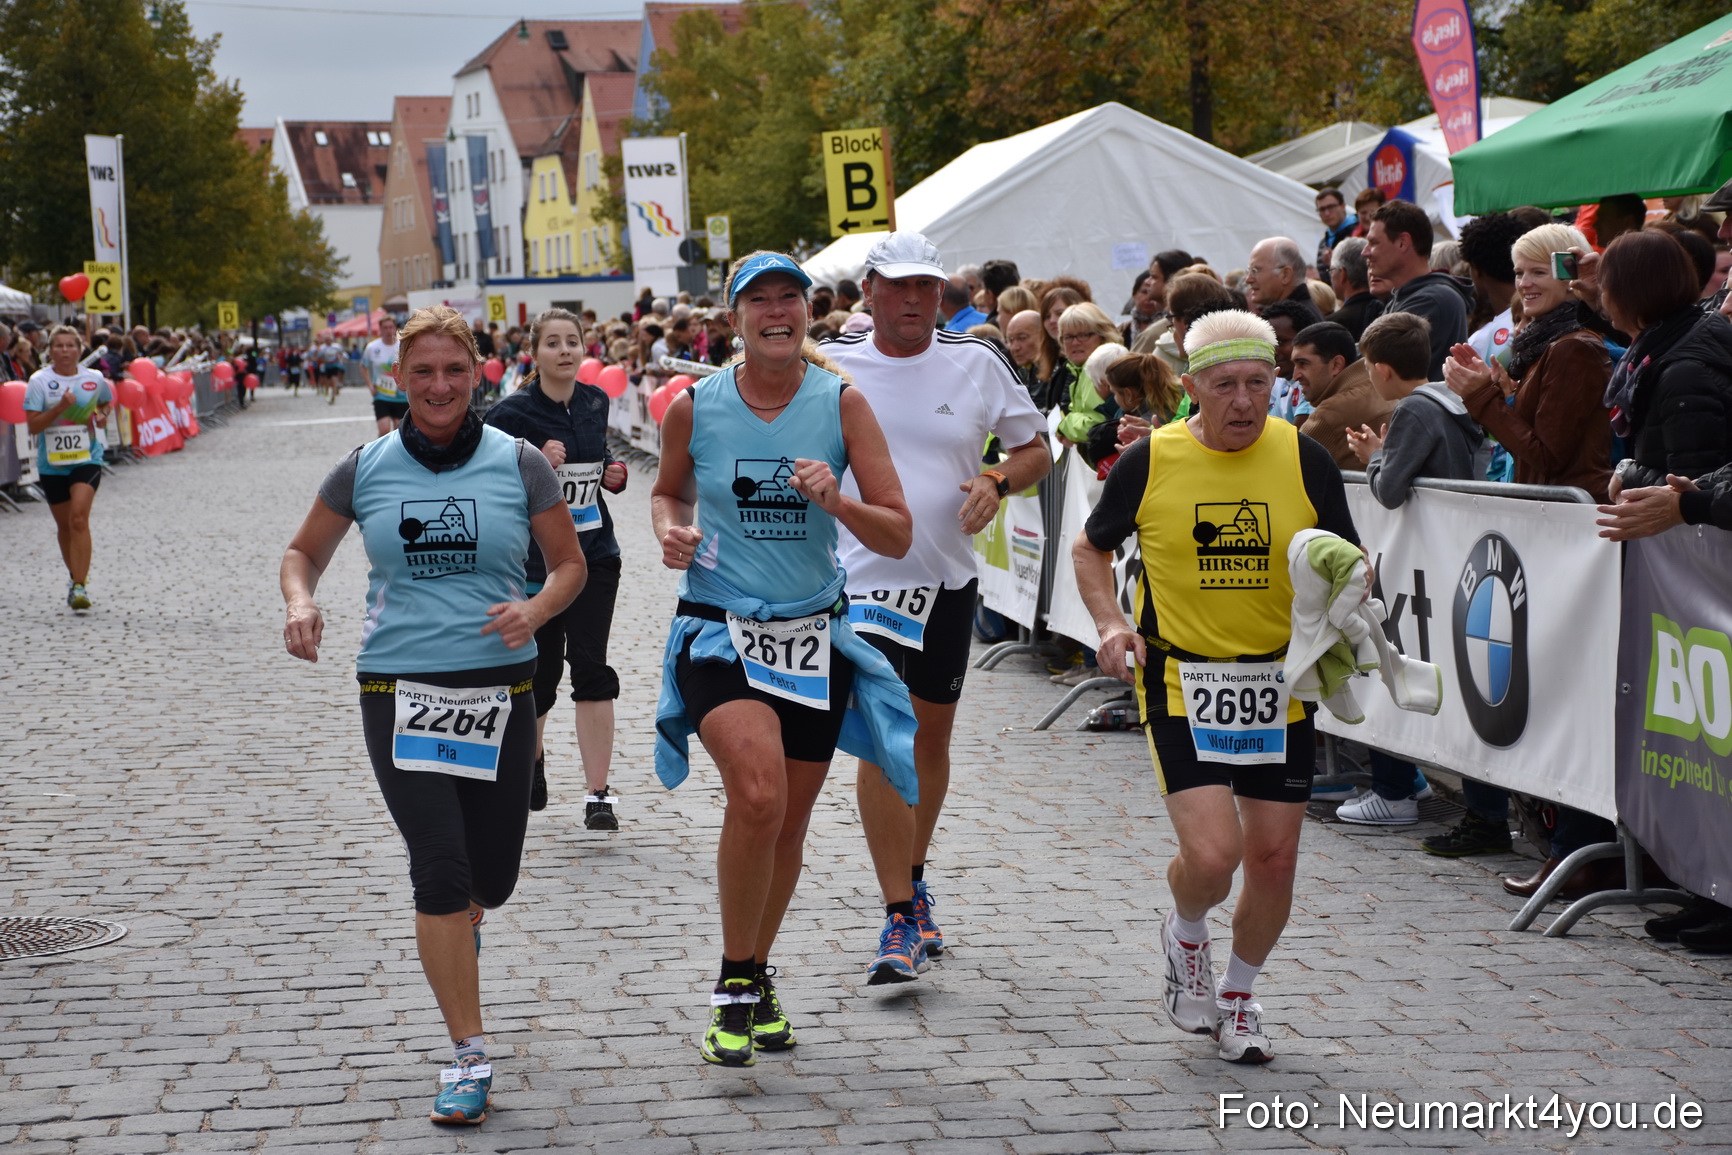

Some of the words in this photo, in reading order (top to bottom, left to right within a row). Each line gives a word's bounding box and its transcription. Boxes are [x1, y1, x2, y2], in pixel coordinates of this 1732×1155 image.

[831, 133, 883, 154] Block
[843, 162, 877, 212] B
[88, 263, 116, 274] Block
[94, 278, 111, 301] C
[224, 310, 233, 324] D
[491, 302, 502, 314] D
[54, 435, 82, 450] 202
[739, 511, 807, 523] HIRSCH
[405, 553, 477, 567] HIRSCH
[1198, 558, 1270, 572] HIRSCH
[1461, 539, 1526, 611] BMW
[864, 608, 903, 632] Werner
[742, 629, 820, 671] 2612
[768, 671, 797, 692] Petra
[1183, 672, 1219, 682] PARTL
[1222, 672, 1272, 683] Neumarkt
[398, 689, 436, 704] PARTL
[439, 695, 492, 706] Neumarkt
[1193, 687, 1279, 726] 2693
[406, 701, 500, 739] 2264
[437, 743, 457, 760] Pia
[1207, 734, 1264, 753] Wolfgang
[1640, 740, 1713, 792] inspired
